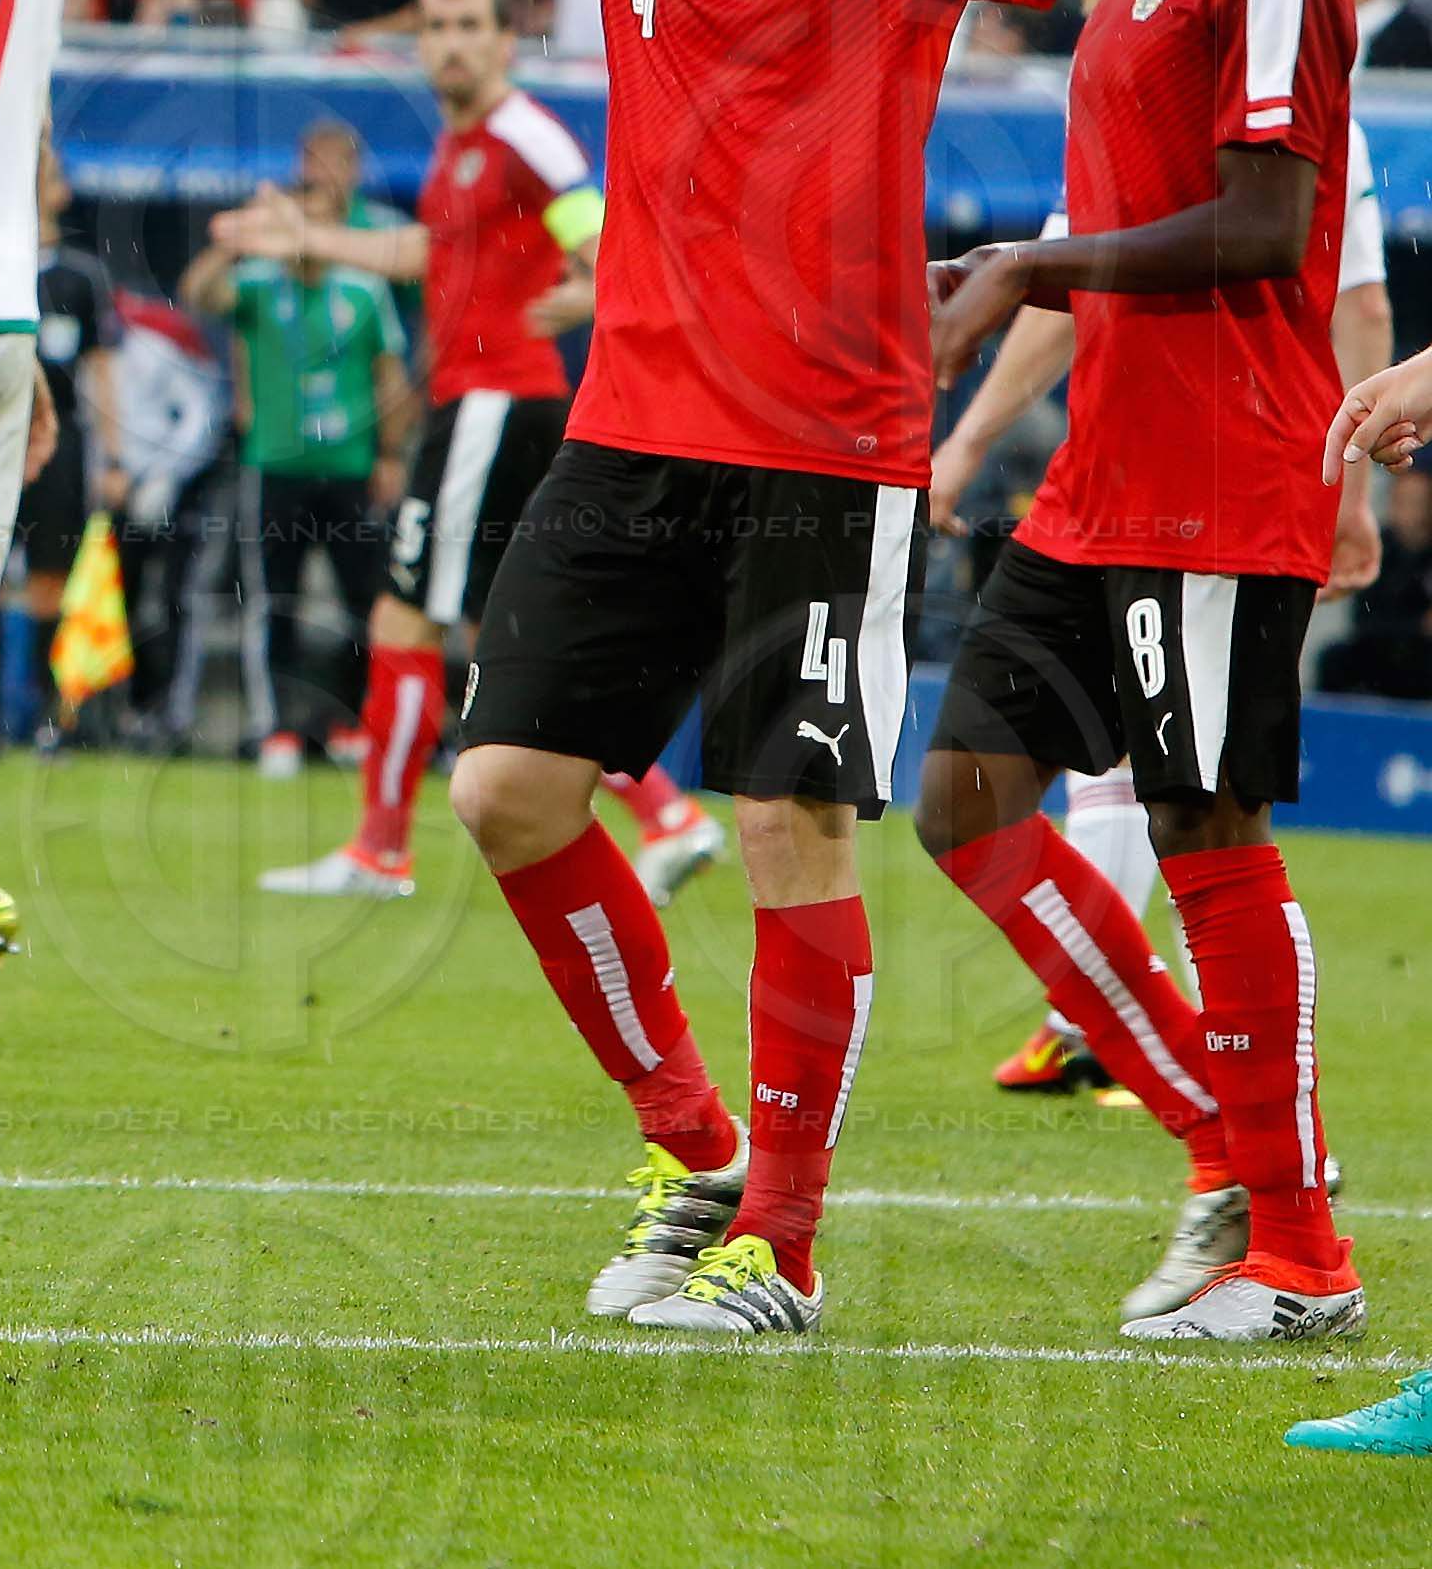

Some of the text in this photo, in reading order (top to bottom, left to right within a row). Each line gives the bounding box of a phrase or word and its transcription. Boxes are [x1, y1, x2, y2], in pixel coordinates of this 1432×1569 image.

[800, 601, 848, 704] 4
[1125, 597, 1167, 700] 8
[1205, 1030, 1250, 1052] ÖFB
[756, 1082, 799, 1109] ÖFB
